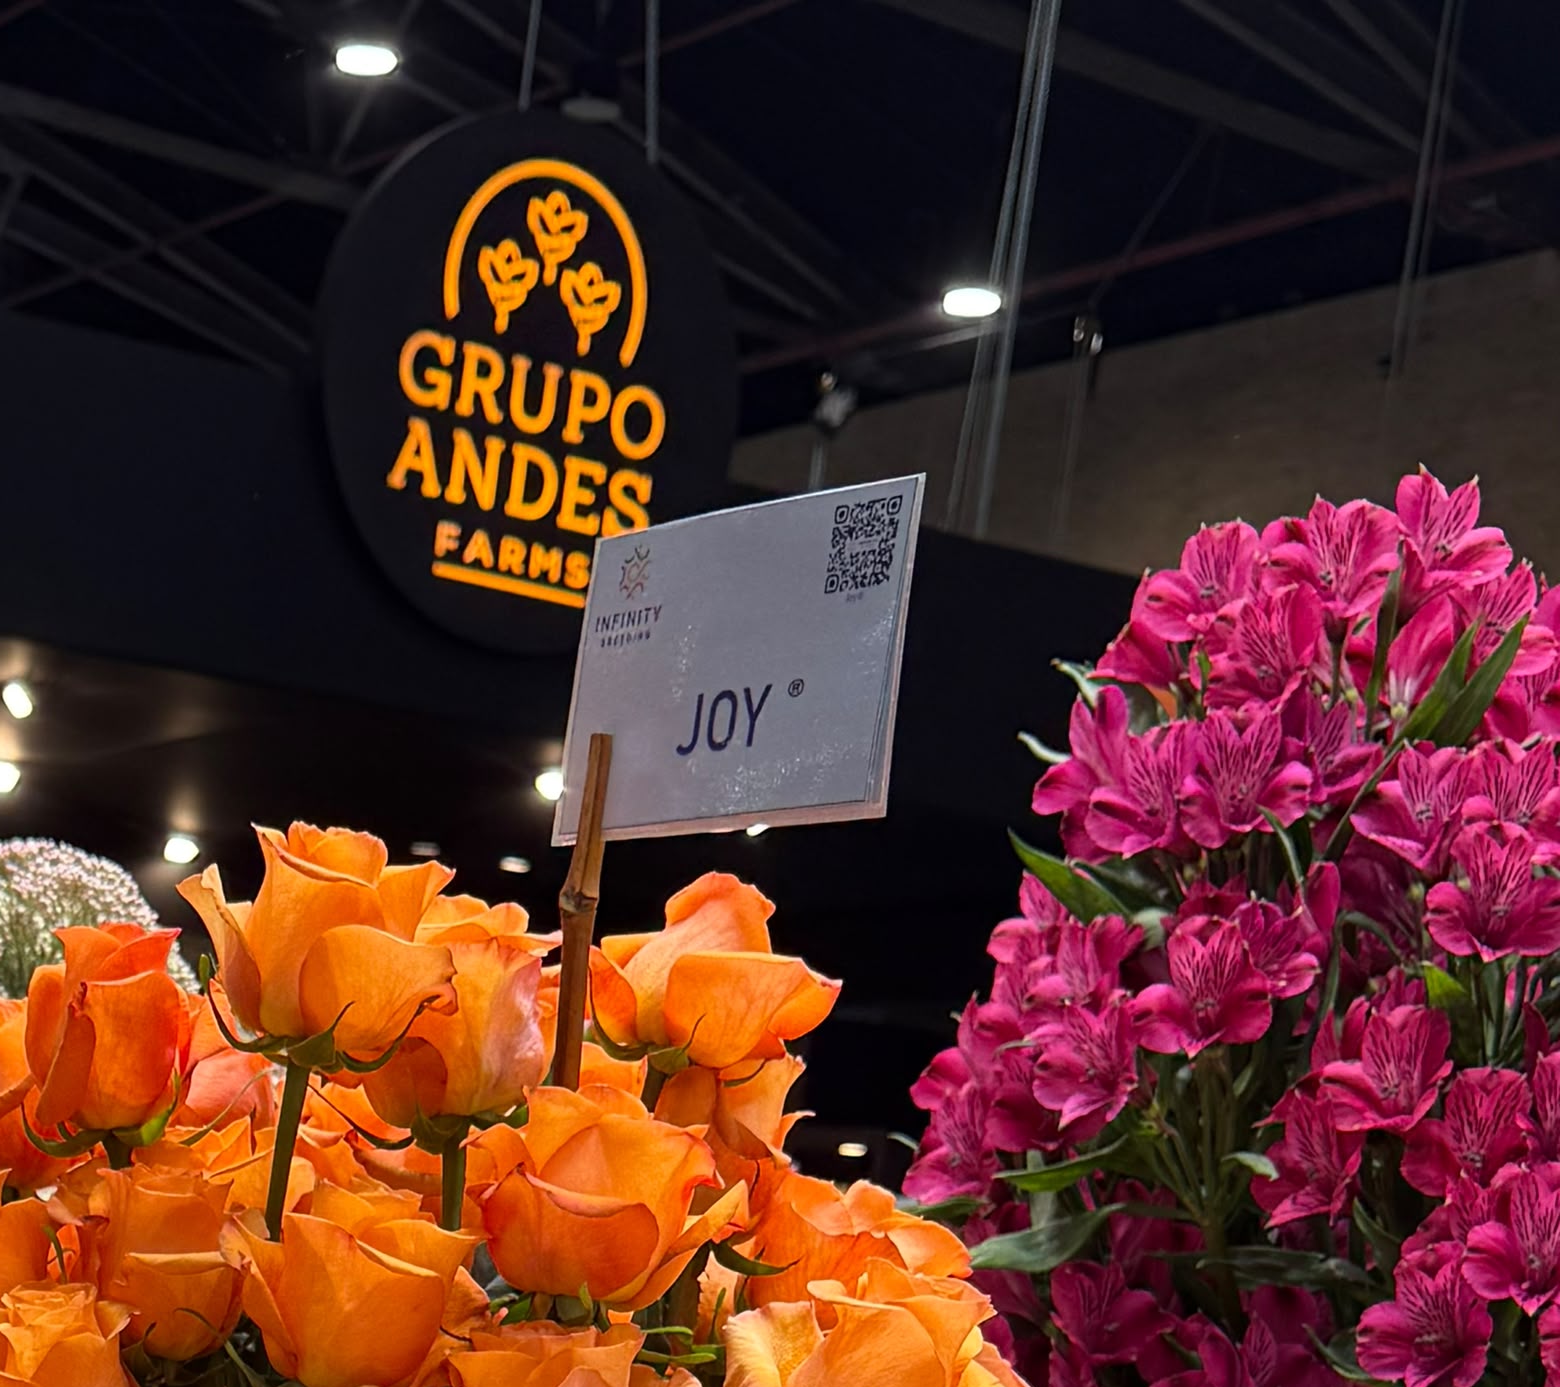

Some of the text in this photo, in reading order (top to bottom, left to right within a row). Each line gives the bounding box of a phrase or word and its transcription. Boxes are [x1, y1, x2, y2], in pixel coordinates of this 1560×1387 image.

[398, 331, 666, 460] GRUPO
[387, 418, 652, 539] ANDES
[434, 523, 591, 590] FARMS
[595, 604, 663, 633] INFINITY
[675, 683, 773, 757] JOY
